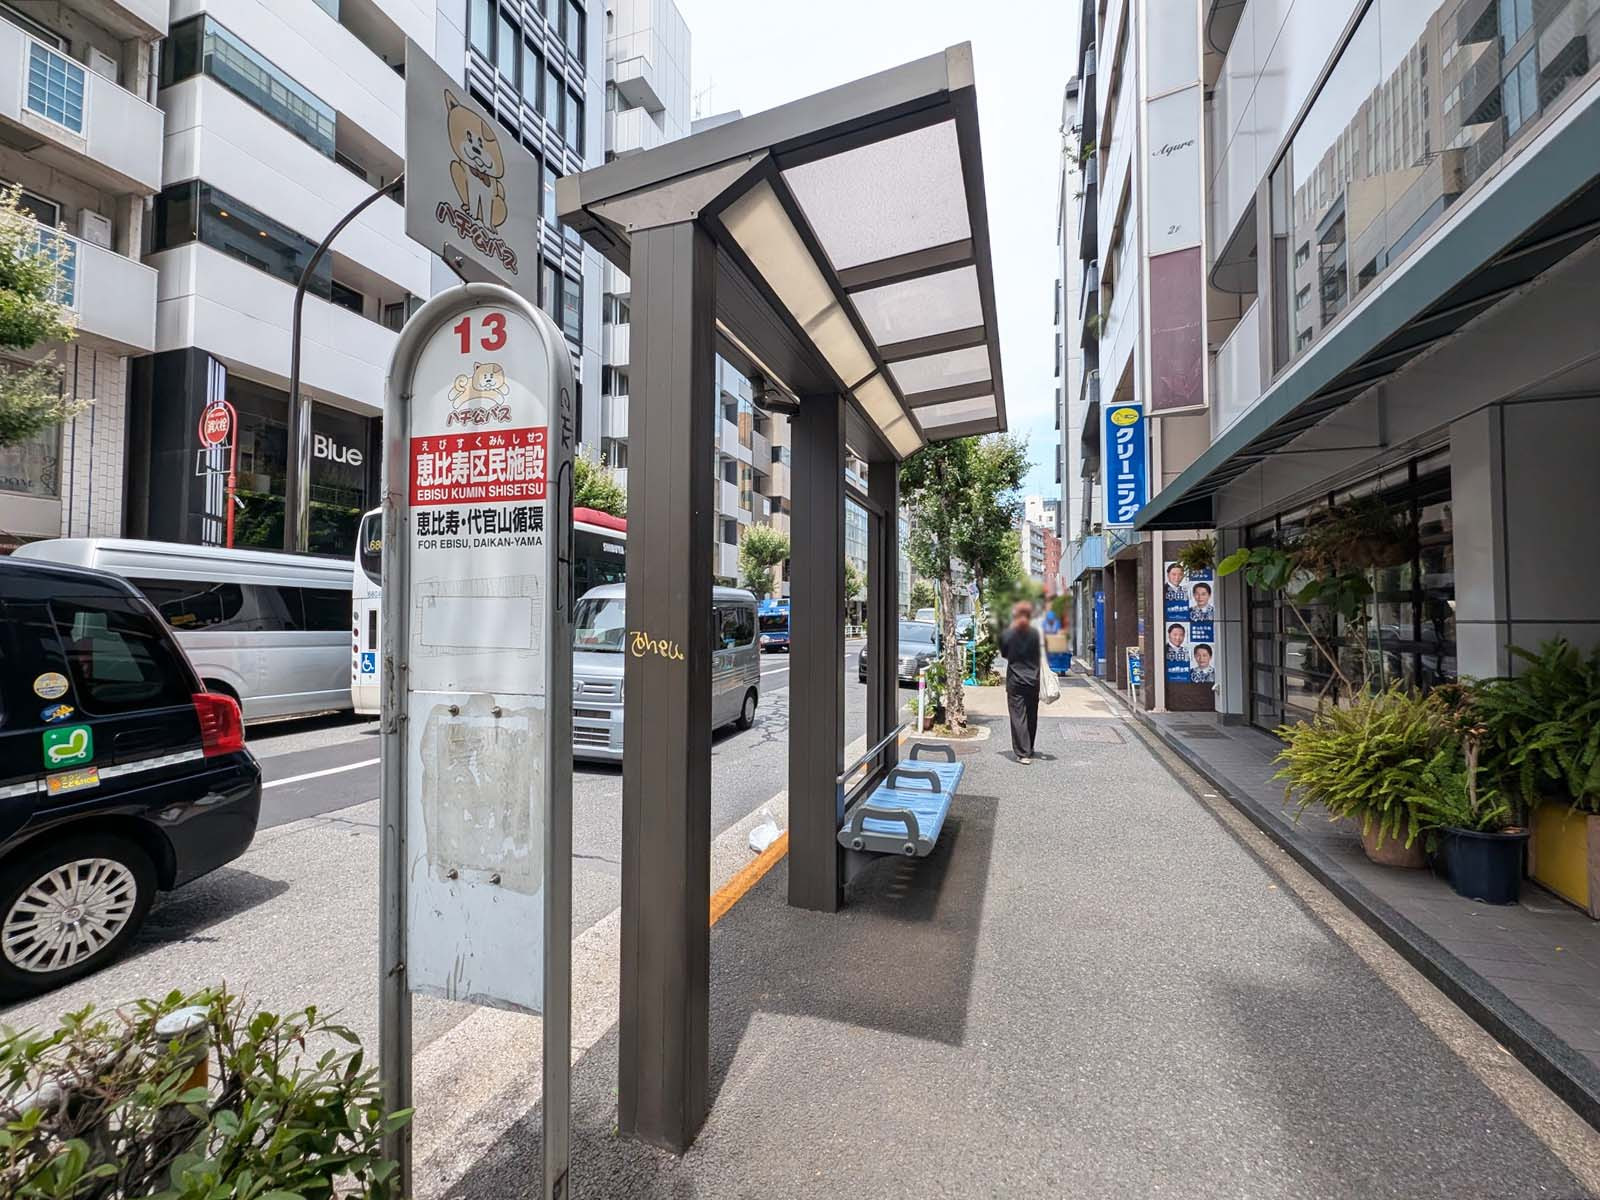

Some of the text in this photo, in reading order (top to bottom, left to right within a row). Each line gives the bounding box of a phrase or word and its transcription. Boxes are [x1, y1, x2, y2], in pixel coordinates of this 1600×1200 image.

[436, 202, 518, 275] ハチ公バス
[453, 312, 508, 354] 13
[446, 406, 512, 427] ハチ公バス
[313, 434, 363, 466] Blue
[416, 445, 545, 487] 恵比寿区民施設
[1116, 427, 1140, 522] クリーニング
[417, 482, 544, 501] EBISU KUMIN SHISETSU
[416, 506, 544, 537] 恵比寿・代官山循環
[418, 536, 543, 550] FOR EBISU, DAIKAN-YAMA
